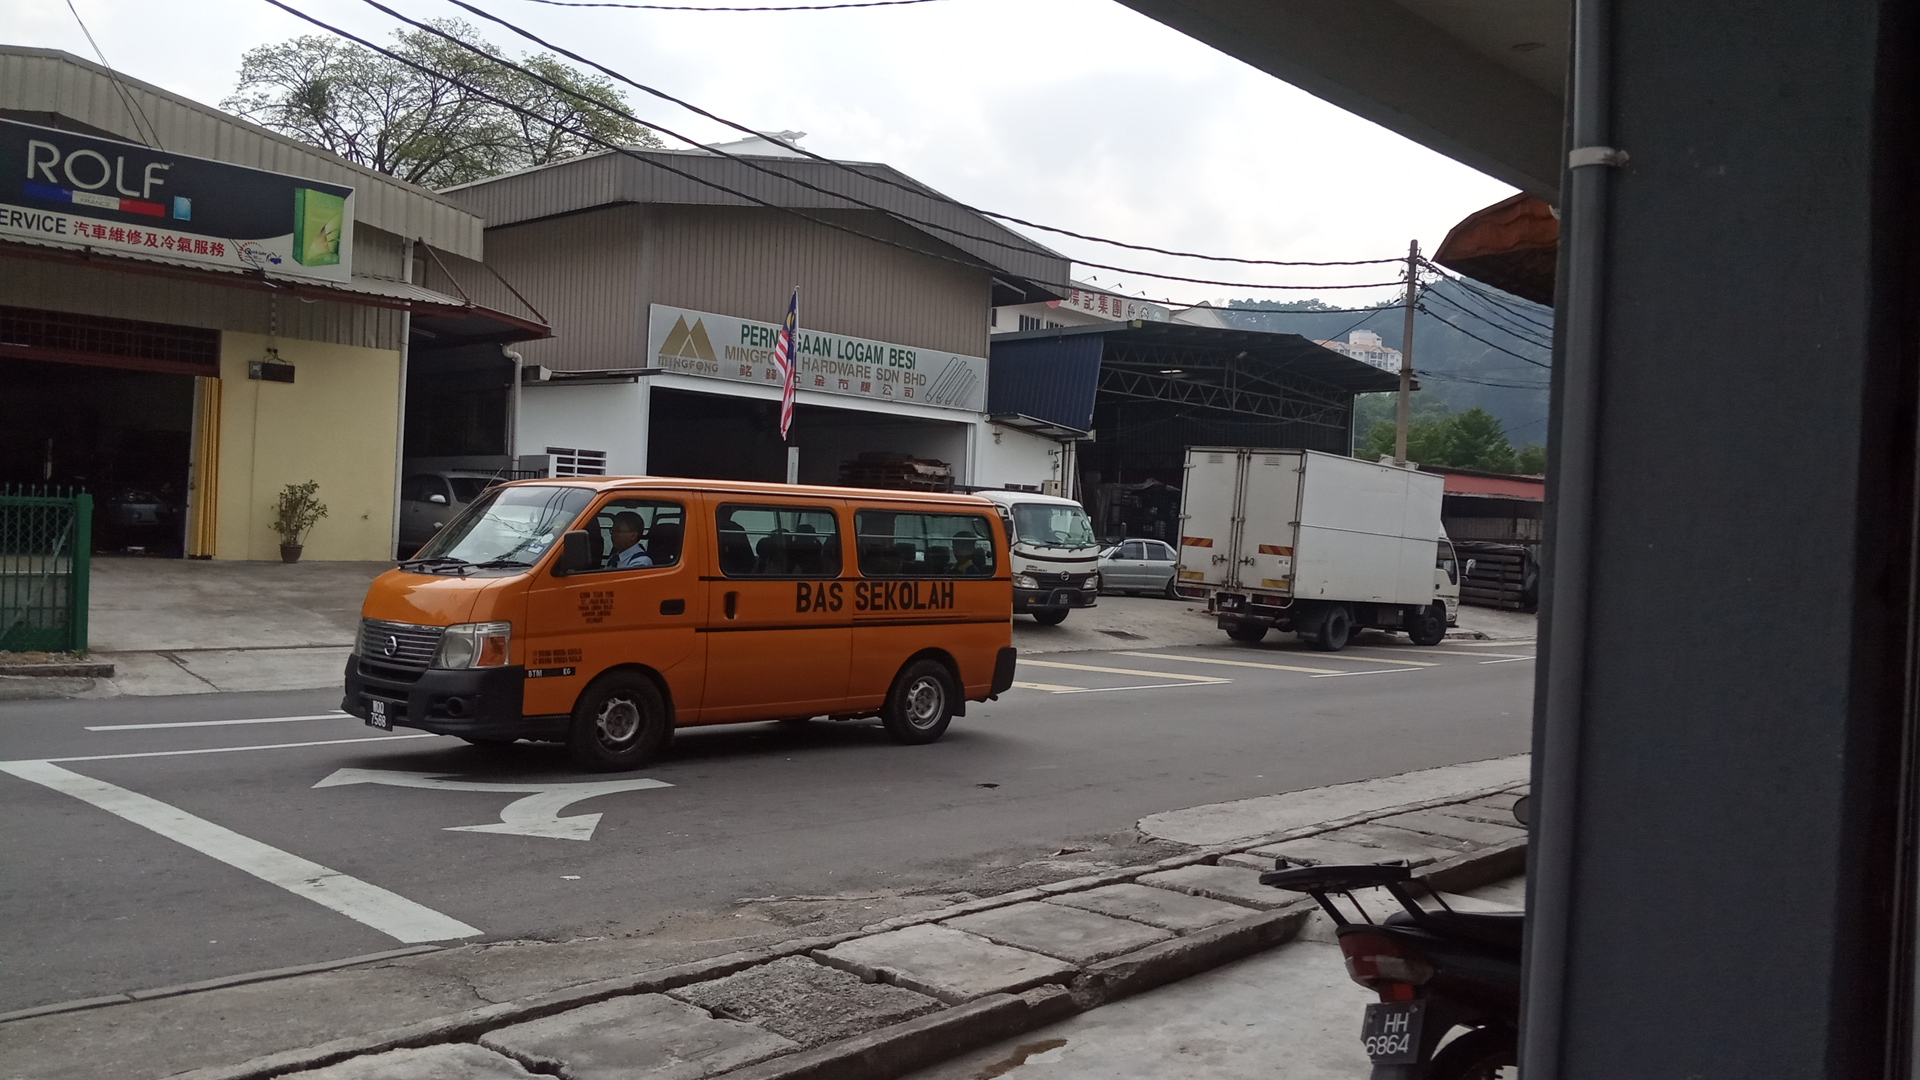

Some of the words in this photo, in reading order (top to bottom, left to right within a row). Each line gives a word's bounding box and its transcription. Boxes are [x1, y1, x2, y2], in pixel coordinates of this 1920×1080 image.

[27, 139, 170, 199] ROLF
[73, 220, 226, 258] 汽車維修及冷氣服務
[741, 324, 832, 357] PERNGAAN
[837, 340, 884, 365] LOGAM
[889, 349, 916, 370] BESI
[802, 356, 871, 379] HARDWARE
[876, 367, 900, 384] SDN
[903, 370, 927, 387] BHD
[796, 582, 843, 612] BAS
[855, 581, 954, 611] SEKOLAH
[528, 669, 543, 678] BTM
[1383, 1012, 1410, 1034] HH
[1365, 1033, 1411, 1056] 6864
